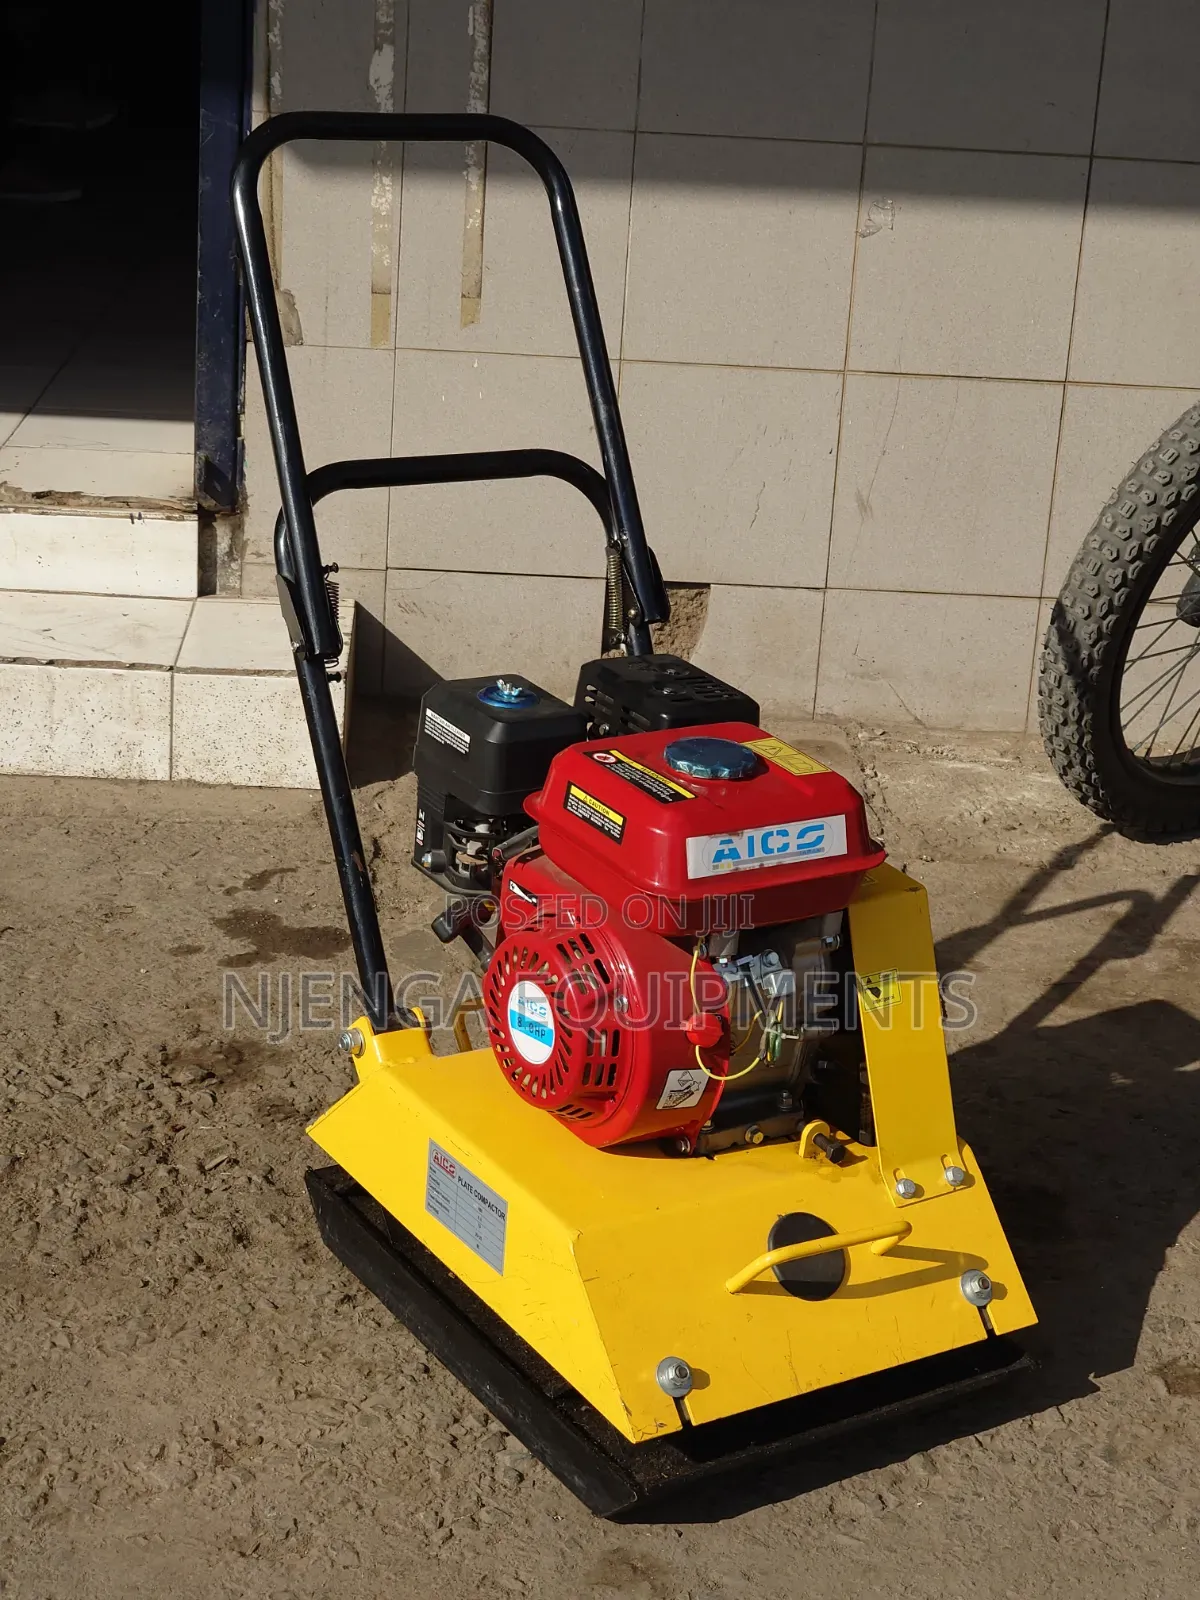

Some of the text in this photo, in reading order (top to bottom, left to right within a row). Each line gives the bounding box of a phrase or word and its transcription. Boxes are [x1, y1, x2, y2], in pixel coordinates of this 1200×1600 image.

[588, 799, 610, 816] CAUTION
[457, 1175, 474, 1195] PLATE
[473, 1189, 506, 1221] COMPACTOR
